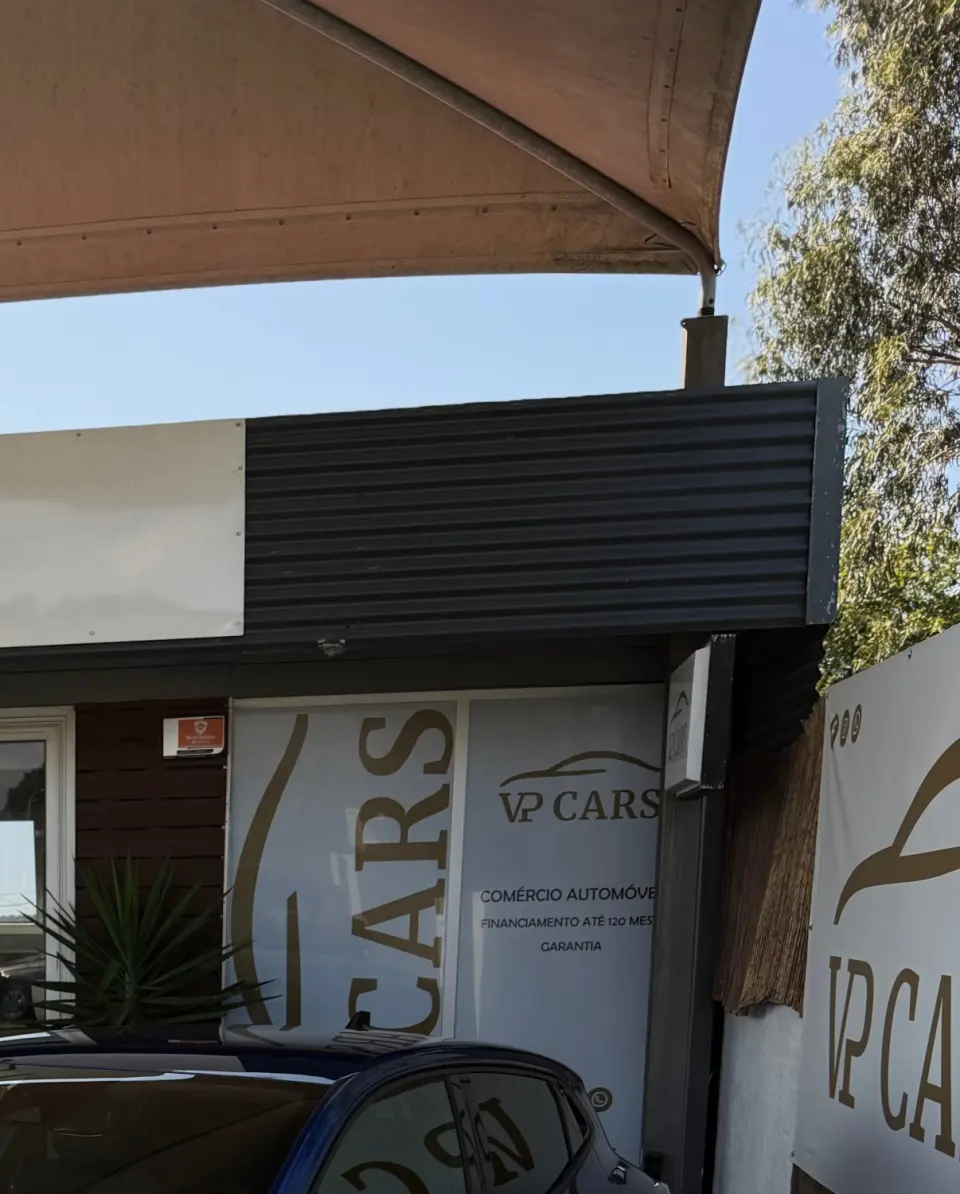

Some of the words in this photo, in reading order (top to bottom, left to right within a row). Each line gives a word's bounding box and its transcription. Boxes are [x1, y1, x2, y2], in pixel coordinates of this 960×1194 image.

[498, 792, 543, 823] VP
[553, 789, 660, 821] CARS
[348, 709, 453, 1036] CARS
[480, 887, 562, 902] COMÉRCIO
[567, 884, 657, 901] AUTOMÓVE
[480, 917, 580, 928] FINANCIAMENTO
[582, 915, 605, 926] ATÉ
[608, 917, 626, 926] 120
[629, 915, 654, 926] MES
[540, 941, 602, 952] GARANTIA
[829, 956, 874, 1109] VP
[881, 968, 960, 1160] CA
